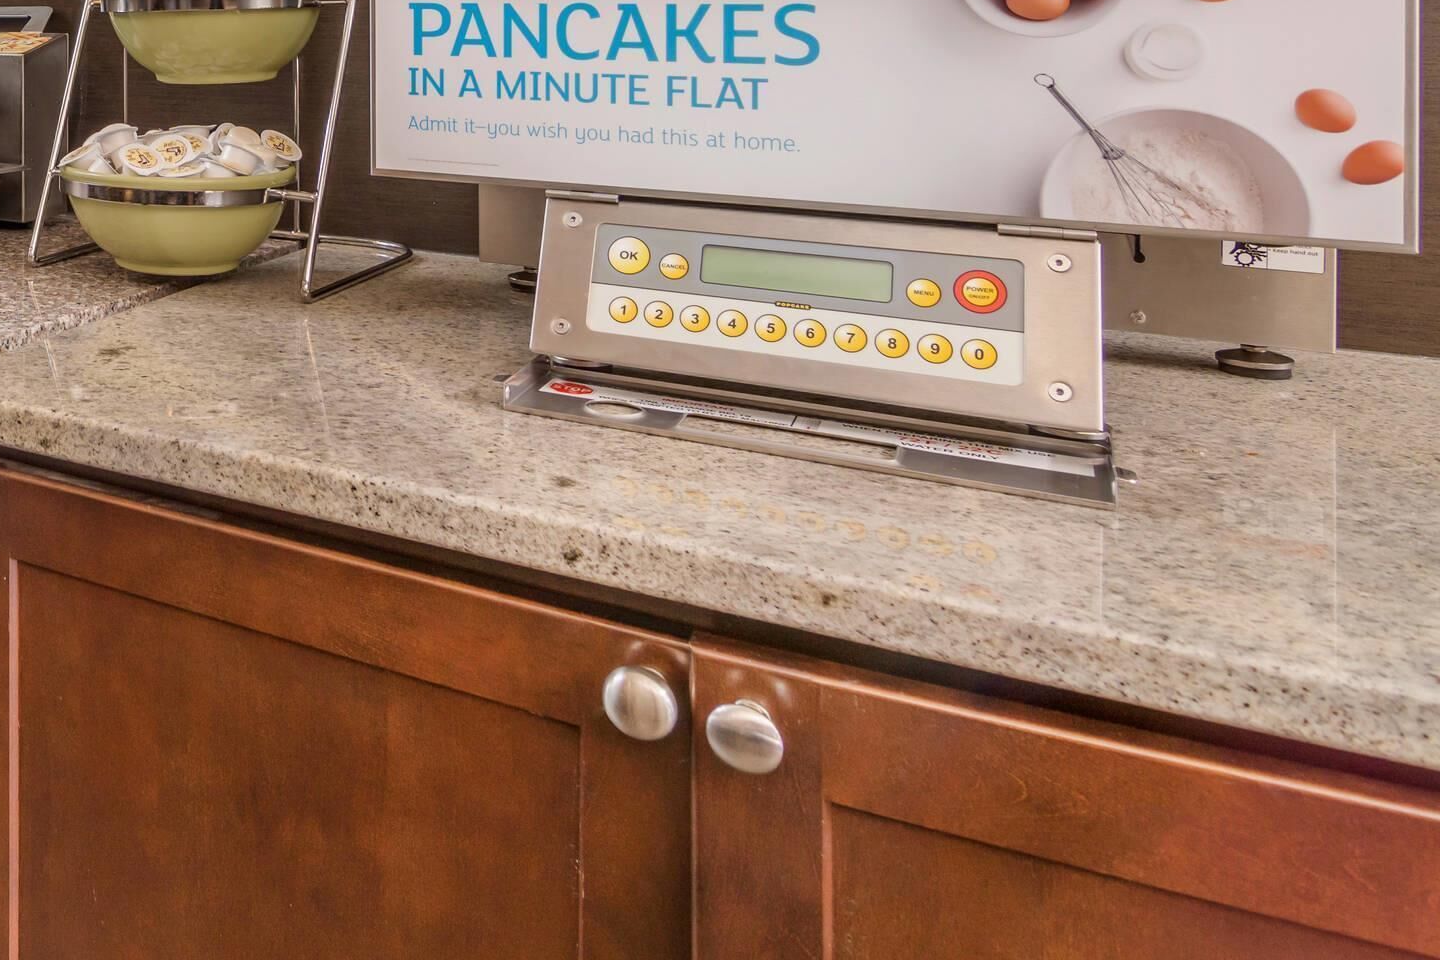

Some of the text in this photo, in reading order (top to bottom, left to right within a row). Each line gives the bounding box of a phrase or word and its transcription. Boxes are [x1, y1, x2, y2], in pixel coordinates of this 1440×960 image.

[409, 3, 820, 66] PANCAKES
[408, 67, 768, 110] IN A MINUTE FLAT
[408, 116, 458, 132] Admit
[527, 123, 567, 139] wish
[575, 127, 610, 144] you
[618, 126, 654, 144] had
[662, 128, 698, 147] this
[706, 132, 725, 148] at
[734, 131, 800, 153] home.
[619, 250, 638, 261] OK
[913, 289, 935, 297] MENU
[965, 285, 995, 294] POWER
[620, 305, 984, 361] 1 2 3 4 5 6 7 8 9 0
[552, 383, 593, 393] STOP
[662, 398, 736, 411] IMPORTANT
[842, 423, 1056, 458] WHEN PREPARING THE MIX USE
[900, 441, 1000, 460] WATER ONLY
